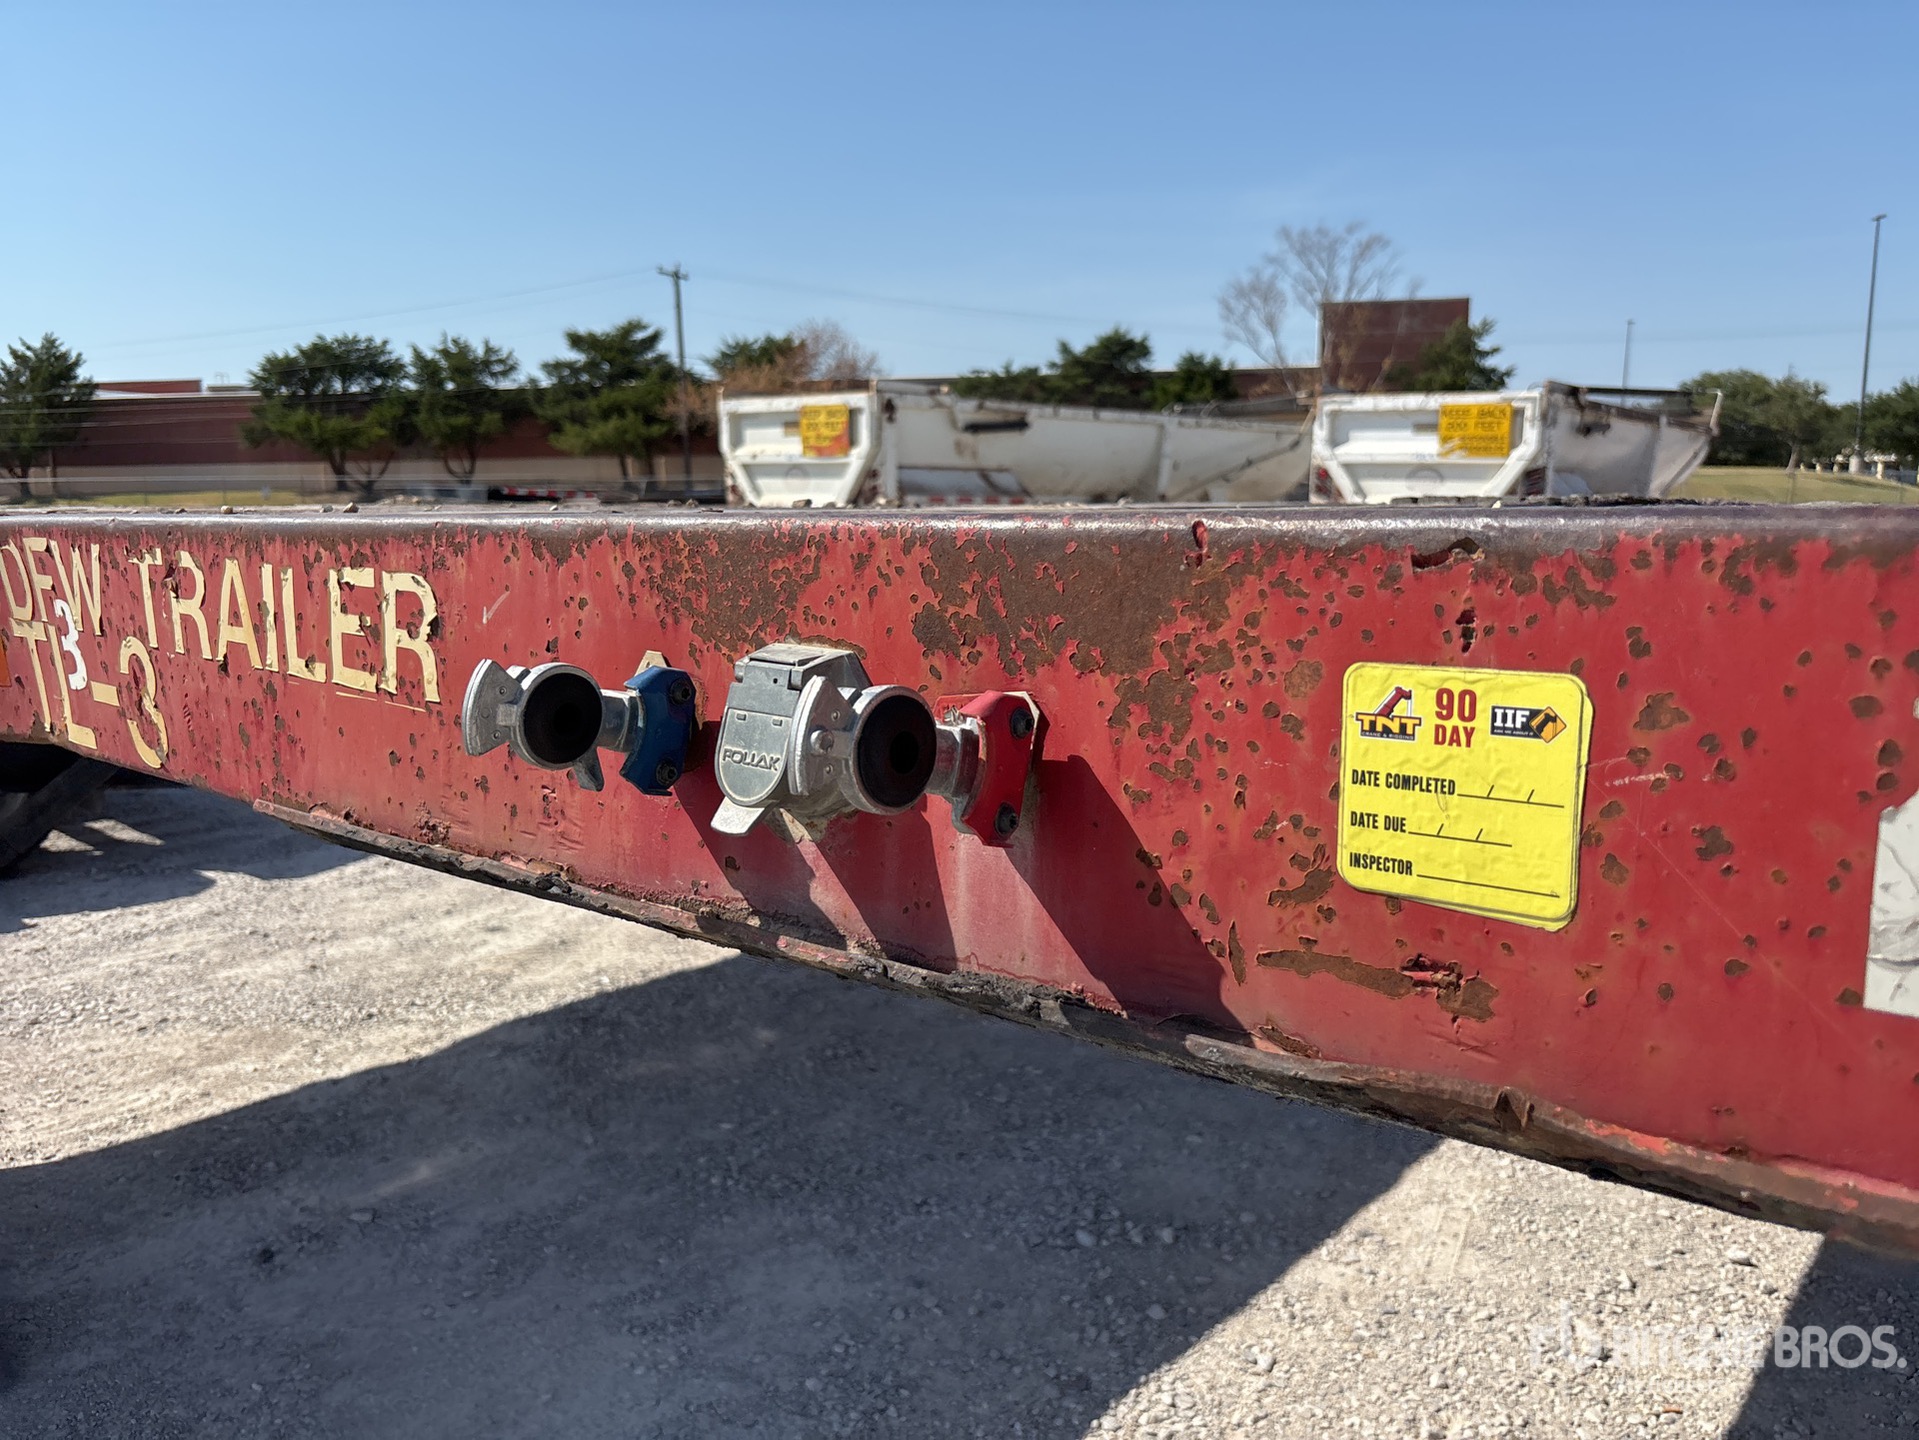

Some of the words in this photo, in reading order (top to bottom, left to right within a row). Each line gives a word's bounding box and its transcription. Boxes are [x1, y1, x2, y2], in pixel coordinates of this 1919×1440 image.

[0, 537, 102, 636] DFW
[128, 547, 440, 703] TRAILER
[54, 598, 88, 691] 3
[1435, 687, 1477, 722] 90
[1356, 713, 1420, 735] TNT
[1493, 708, 1530, 728] IIF
[1433, 724, 1476, 748] DAY
[722, 747, 781, 771] POLLAK
[1351, 769, 1380, 788] DATE
[1385, 772, 1456, 796] COMPLETED
[1350, 811, 1378, 830] DATE
[1384, 815, 1407, 834] DUE
[1349, 852, 1413, 876] INSPECTOR
